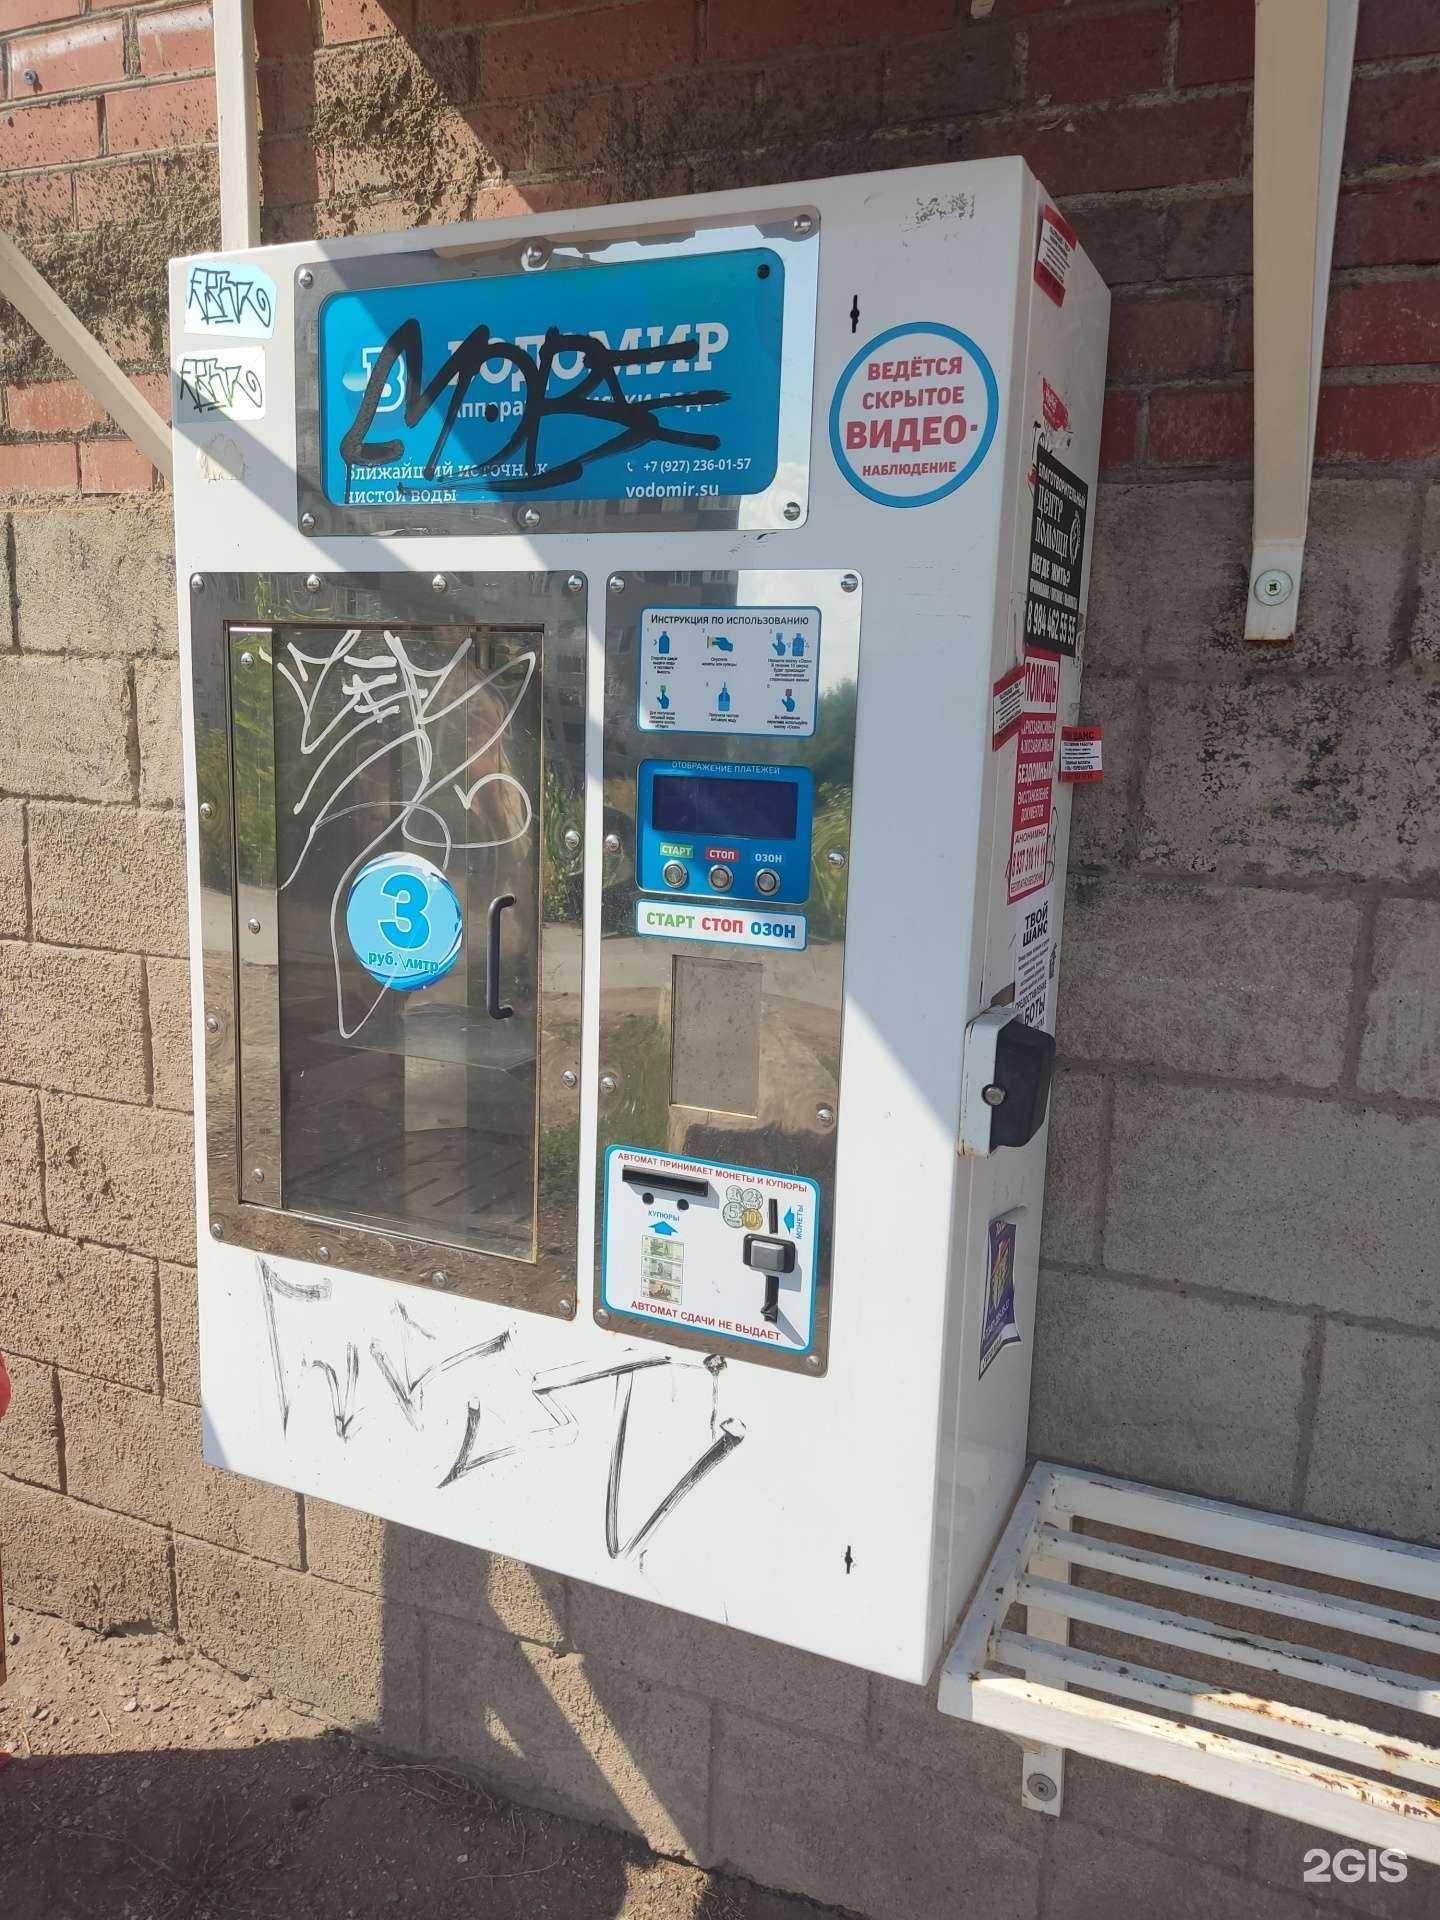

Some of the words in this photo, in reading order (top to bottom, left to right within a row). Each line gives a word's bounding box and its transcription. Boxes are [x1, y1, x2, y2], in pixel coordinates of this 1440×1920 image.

[866, 355, 963, 382] ВЕДЁТСЯ
[862, 385, 965, 410] СКРЫТОЕ
[845, 413, 978, 453] ВИДЕО-
[643, 461, 657, 472] +7
[659, 459, 691, 474] (927)
[693, 457, 752, 471] 236-01-57
[862, 460, 957, 477] НАБЛЮДЕНИЕ
[411, 488, 457, 504] воды
[626, 481, 720, 498] vodomir.su
[1035, 516, 1069, 562] ПОМОЩИ
[1026, 600, 1033, 633] 8
[1025, 662, 1057, 711] ПОМОЩЬ
[671, 760, 733, 774] ОТОБРАЖЕНИЕ
[733, 765, 781, 775] ПЛАТЕЖЕЙ
[1015, 827, 1047, 844] АНОНИМНО
[661, 845, 692, 856] СТАРТ
[709, 849, 735, 860] СТОП
[754, 853, 783, 863] ОЗОН
[377, 871, 432, 952] 3
[646, 911, 695, 929] СТАРТ
[701, 917, 743, 933] СТОП
[750, 921, 796, 939] ОЗОН
[1024, 900, 1049, 931] ТВОЙ
[1022, 919, 1048, 948] ШАНС
[368, 951, 398, 968] руб.
[617, 1152, 658, 1167] АВТОМАТ
[660, 1159, 713, 1176] ПРИНИМАЕТ
[715, 1168, 755, 1183] МОНЕТЫ
[765, 1178, 808, 1193] КУПЮРЫ
[648, 1210, 680, 1222] КУПЮРЫ
[796, 1204, 804, 1239] МОНЕТЫ
[630, 1300, 677, 1318] АВТОМАТ
[680, 1311, 715, 1327] СДАЧИ
[718, 1320, 731, 1330] НЕ
[735, 1322, 781, 1341] ВЫДАЕТ
